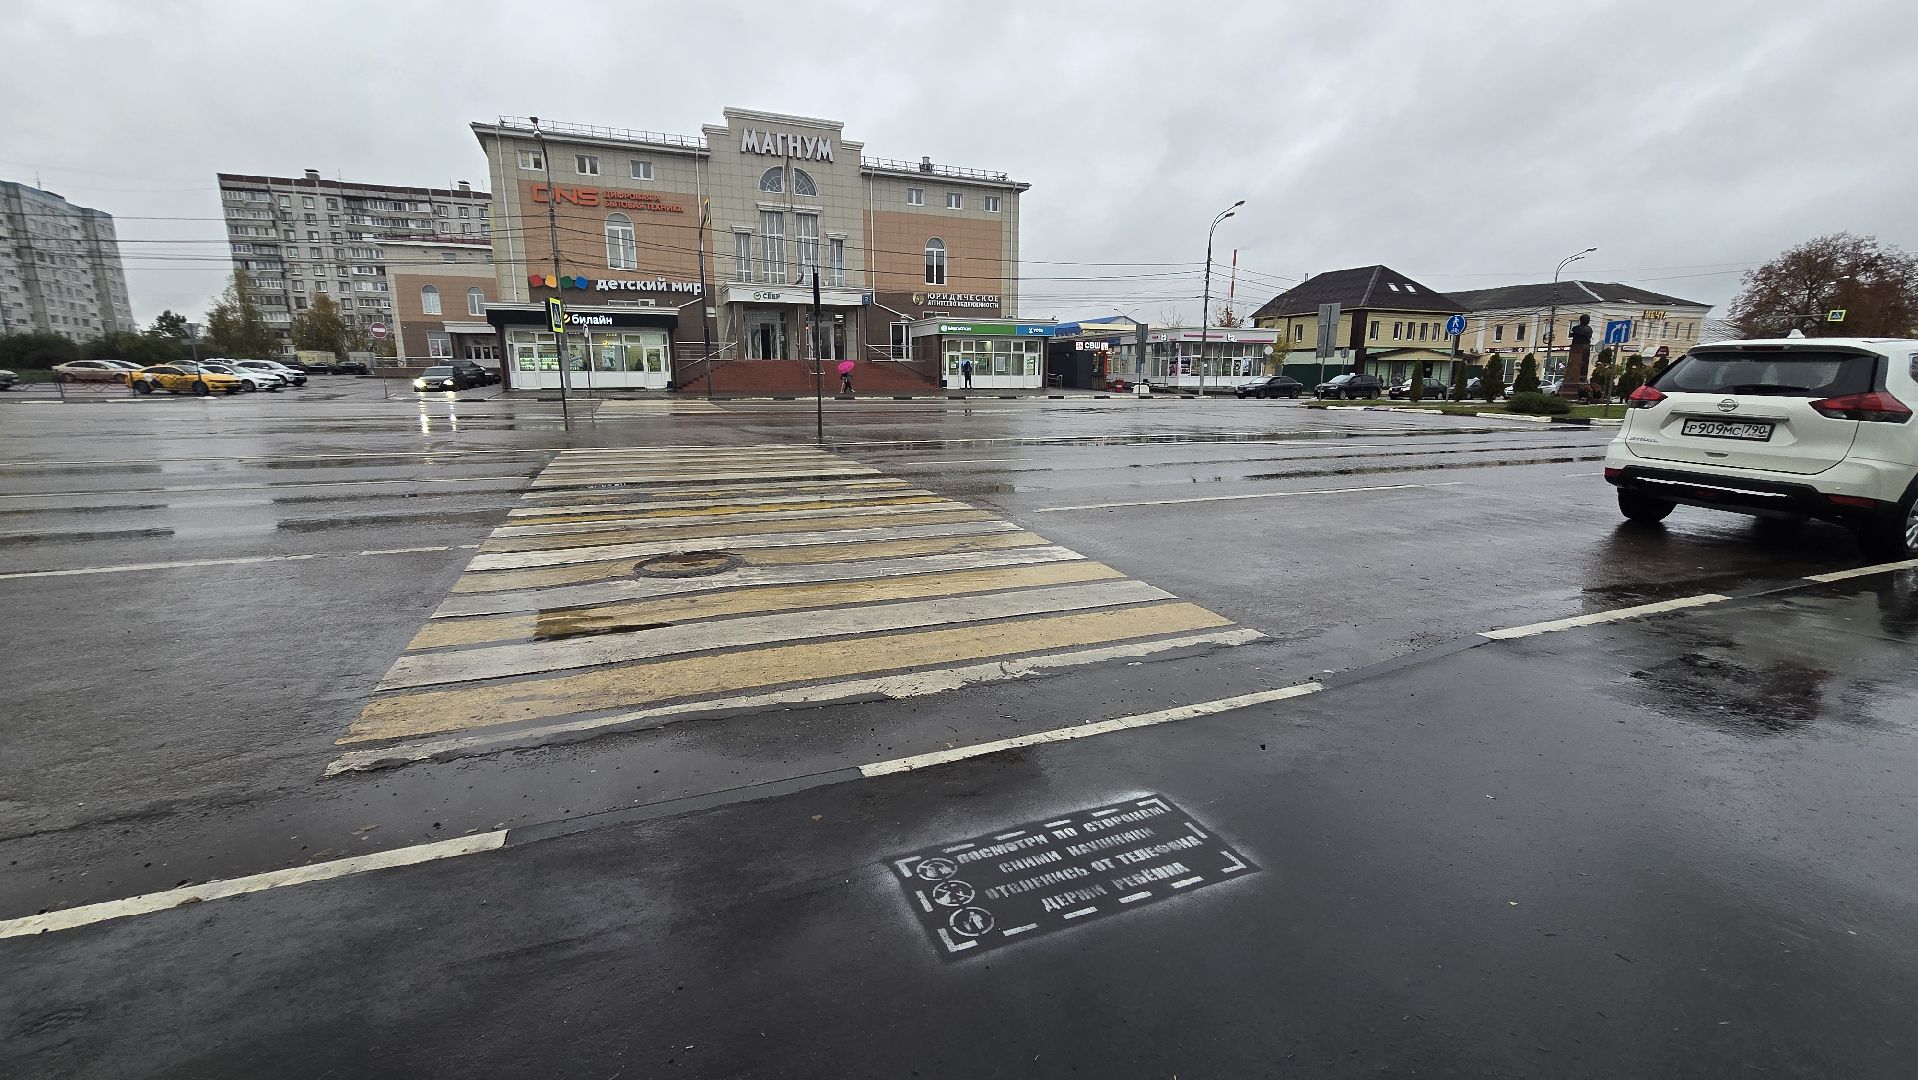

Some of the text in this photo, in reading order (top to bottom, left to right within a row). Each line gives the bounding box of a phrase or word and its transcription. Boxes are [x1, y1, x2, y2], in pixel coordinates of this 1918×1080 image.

[740, 126, 833, 162] МАГНУМ
[532, 183, 599, 206] DNS
[604, 191, 652, 201] ЦИФРОВАЯ
[604, 201, 683, 213] БЫТОВАЯ ТЕХНИКА
[596, 277, 702, 295] детский мир
[927, 293, 999, 303] ЮРИДИЧЕСКОЕ
[572, 314, 613, 325] билайн
[957, 806, 1165, 864] ПОСМОТРИ ПО СТОРОНАМ
[999, 827, 1156, 873] СНИМИ НАУШНИКИ
[984, 835, 1203, 900] ОТВЛЕКИСЬ ОТ ТЕЛЕФОНА
[1041, 884, 1107, 913] ДЕРЖИ
